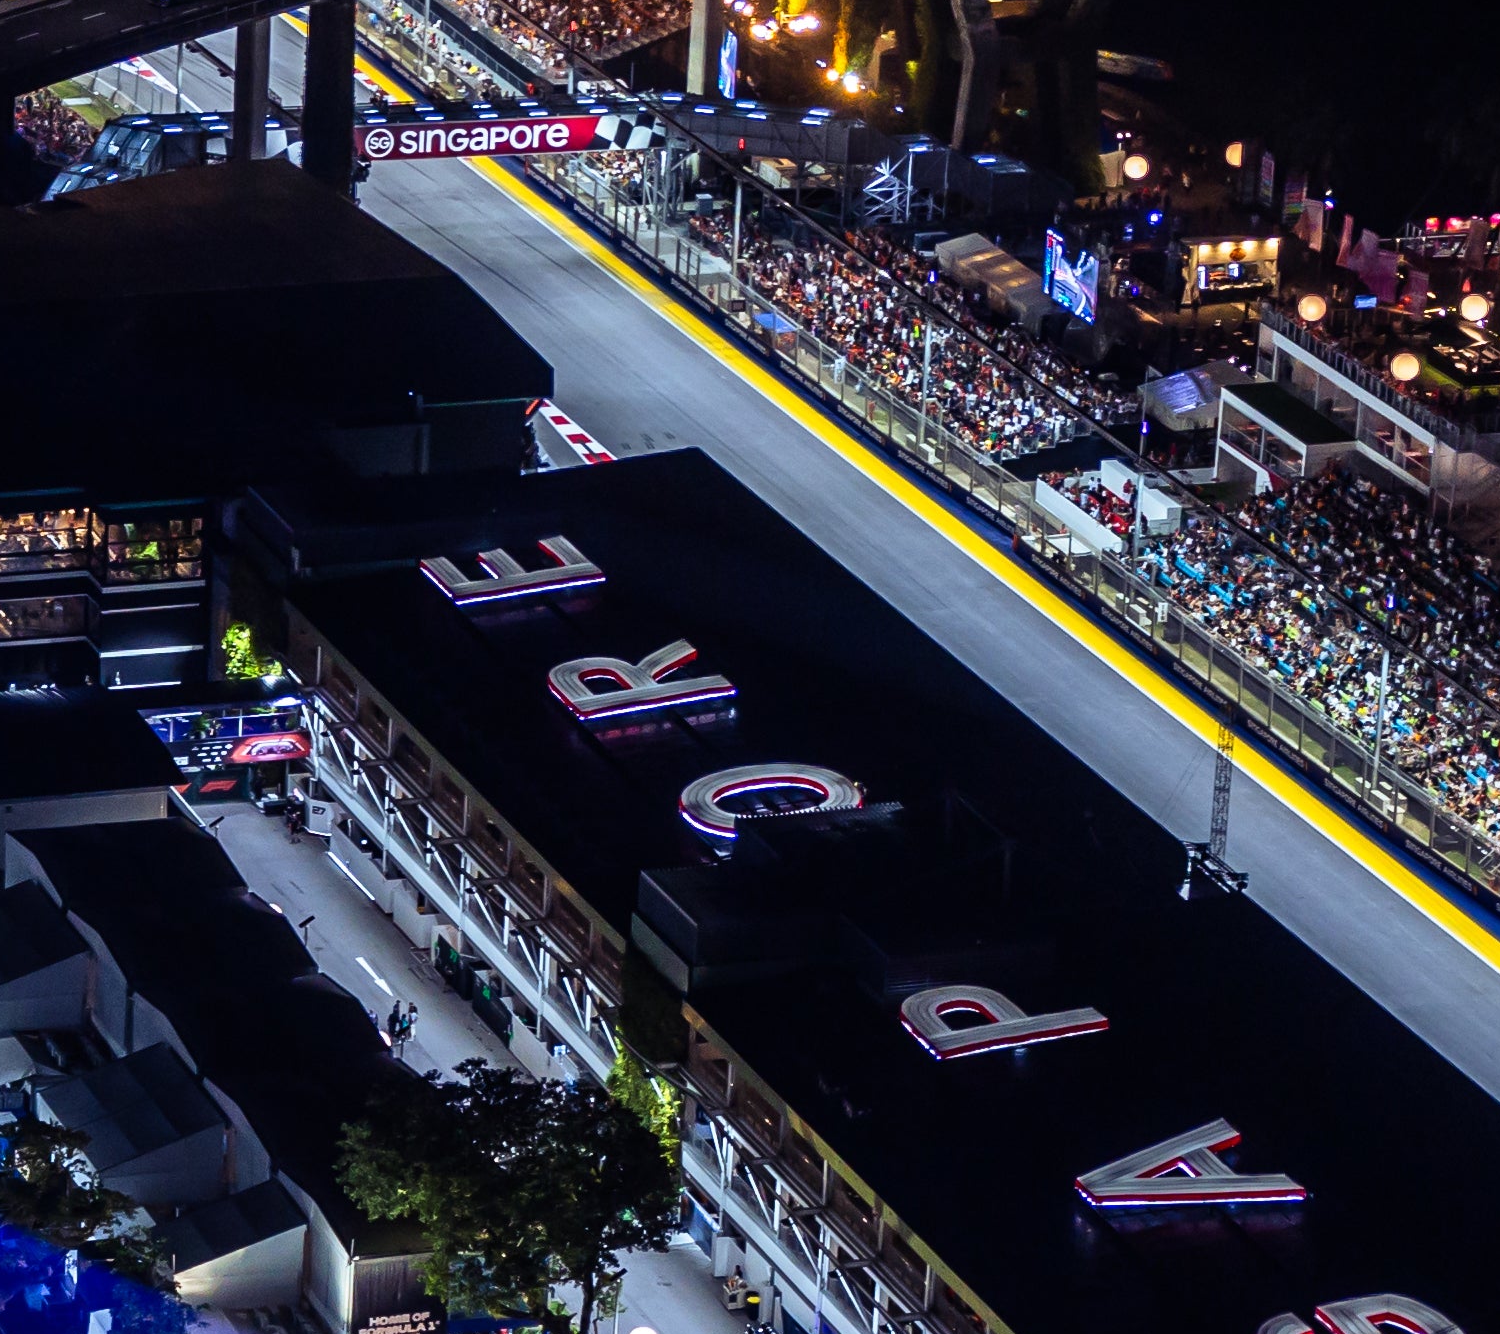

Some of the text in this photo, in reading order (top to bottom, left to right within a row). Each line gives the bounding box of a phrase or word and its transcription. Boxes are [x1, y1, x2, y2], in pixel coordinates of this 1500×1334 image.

[368, 136, 391, 149] SG
[369, 1311, 430, 1327] HOME OF
